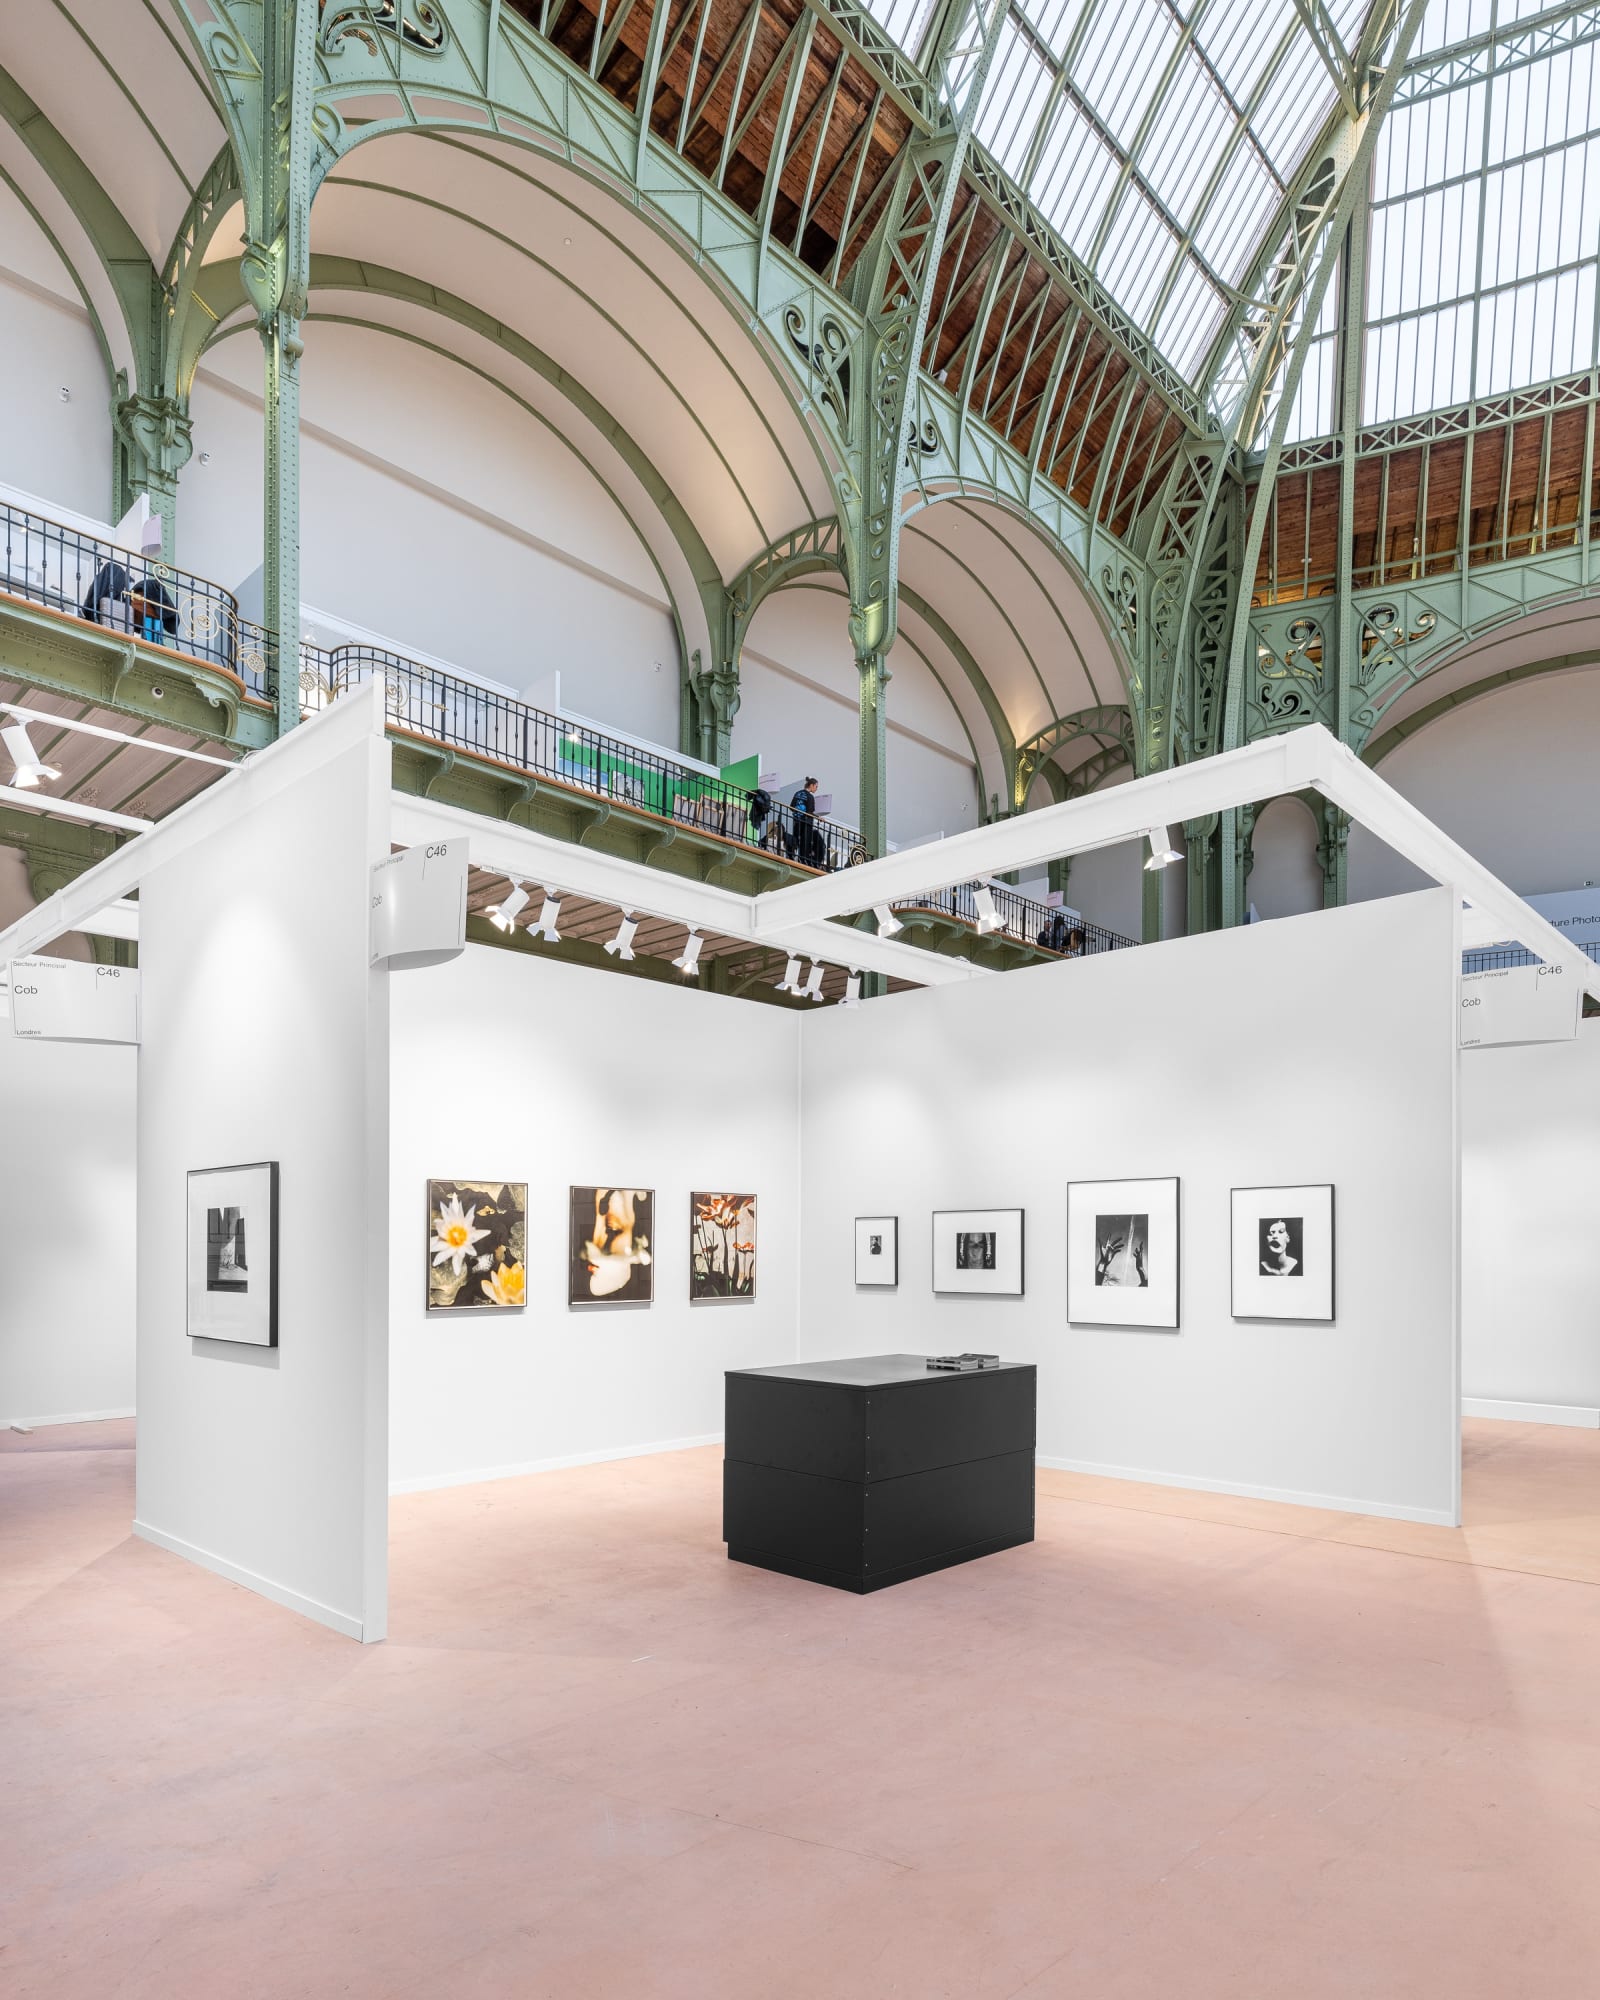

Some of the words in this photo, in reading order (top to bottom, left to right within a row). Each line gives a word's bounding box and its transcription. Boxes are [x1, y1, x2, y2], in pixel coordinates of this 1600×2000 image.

[426, 844, 447, 859] C46
[96, 966, 121, 978] C46
[1538, 966, 1563, 976] C46
[14, 985, 38, 995] Cob
[1461, 997, 1481, 1008] Cob
